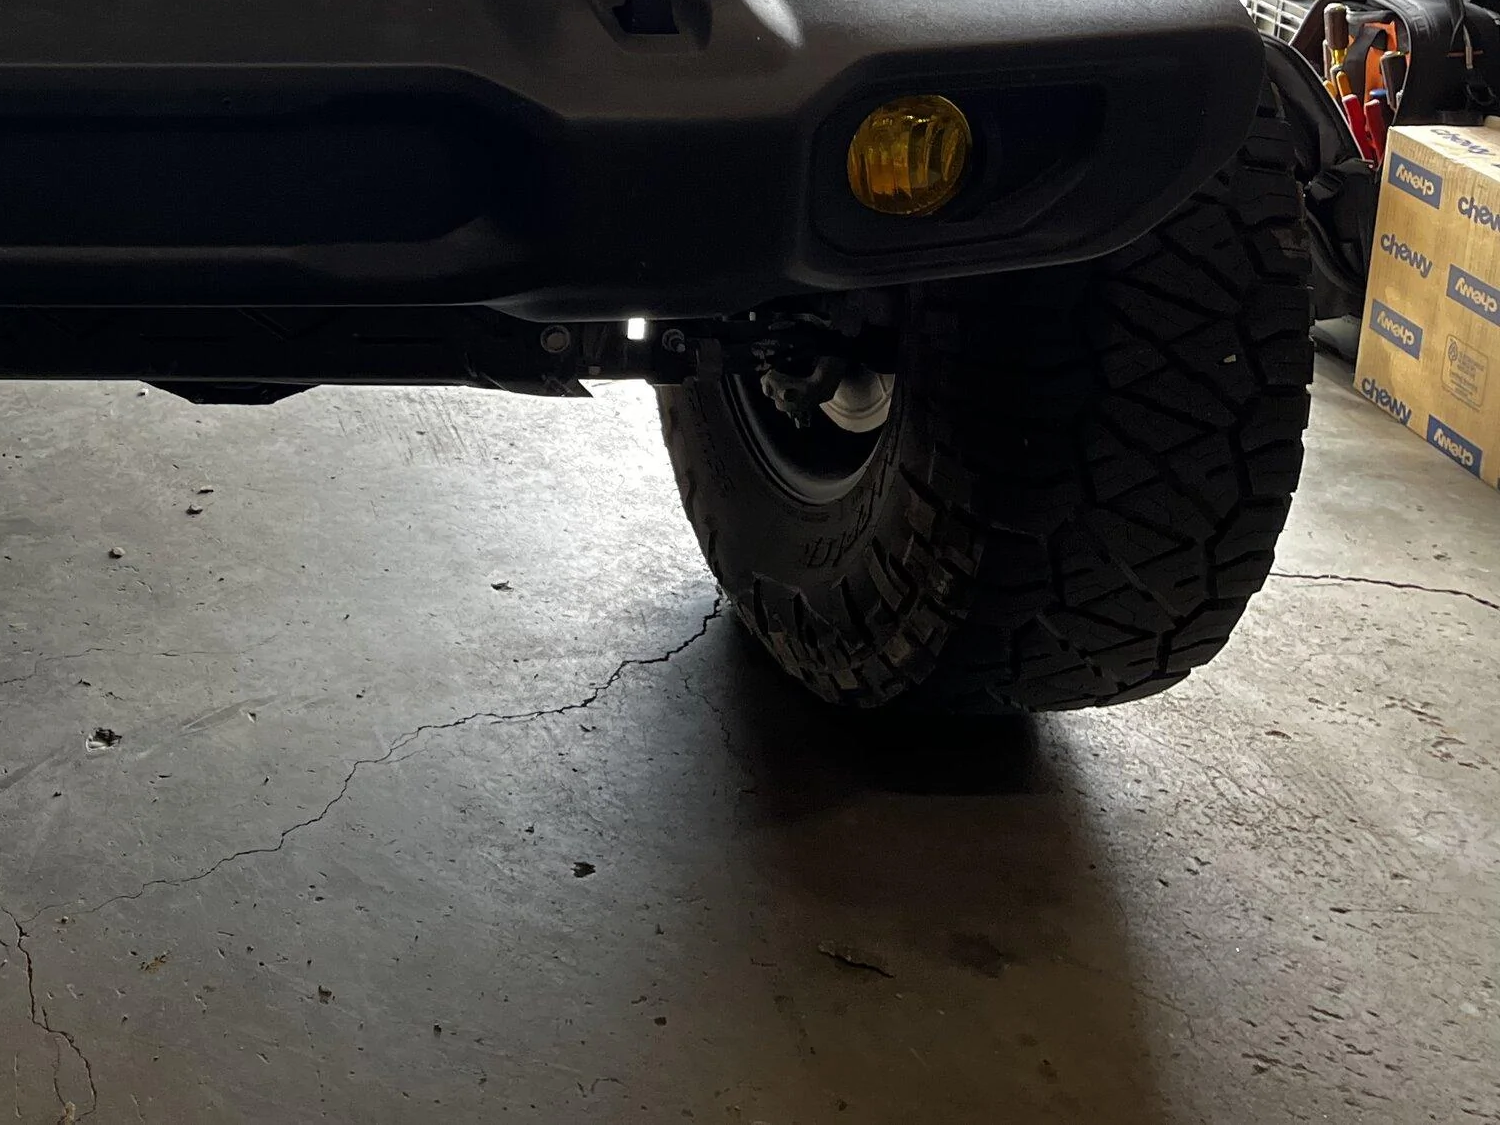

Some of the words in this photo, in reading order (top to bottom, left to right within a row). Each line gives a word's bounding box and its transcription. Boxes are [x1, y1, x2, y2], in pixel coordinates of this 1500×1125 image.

[1395, 163, 1435, 196] chewy
[1380, 233, 1433, 279] chewy
[1454, 277, 1498, 313] chewy
[1377, 310, 1415, 346] chewy
[1361, 378, 1412, 426] chewy
[1433, 427, 1474, 467] chewy
